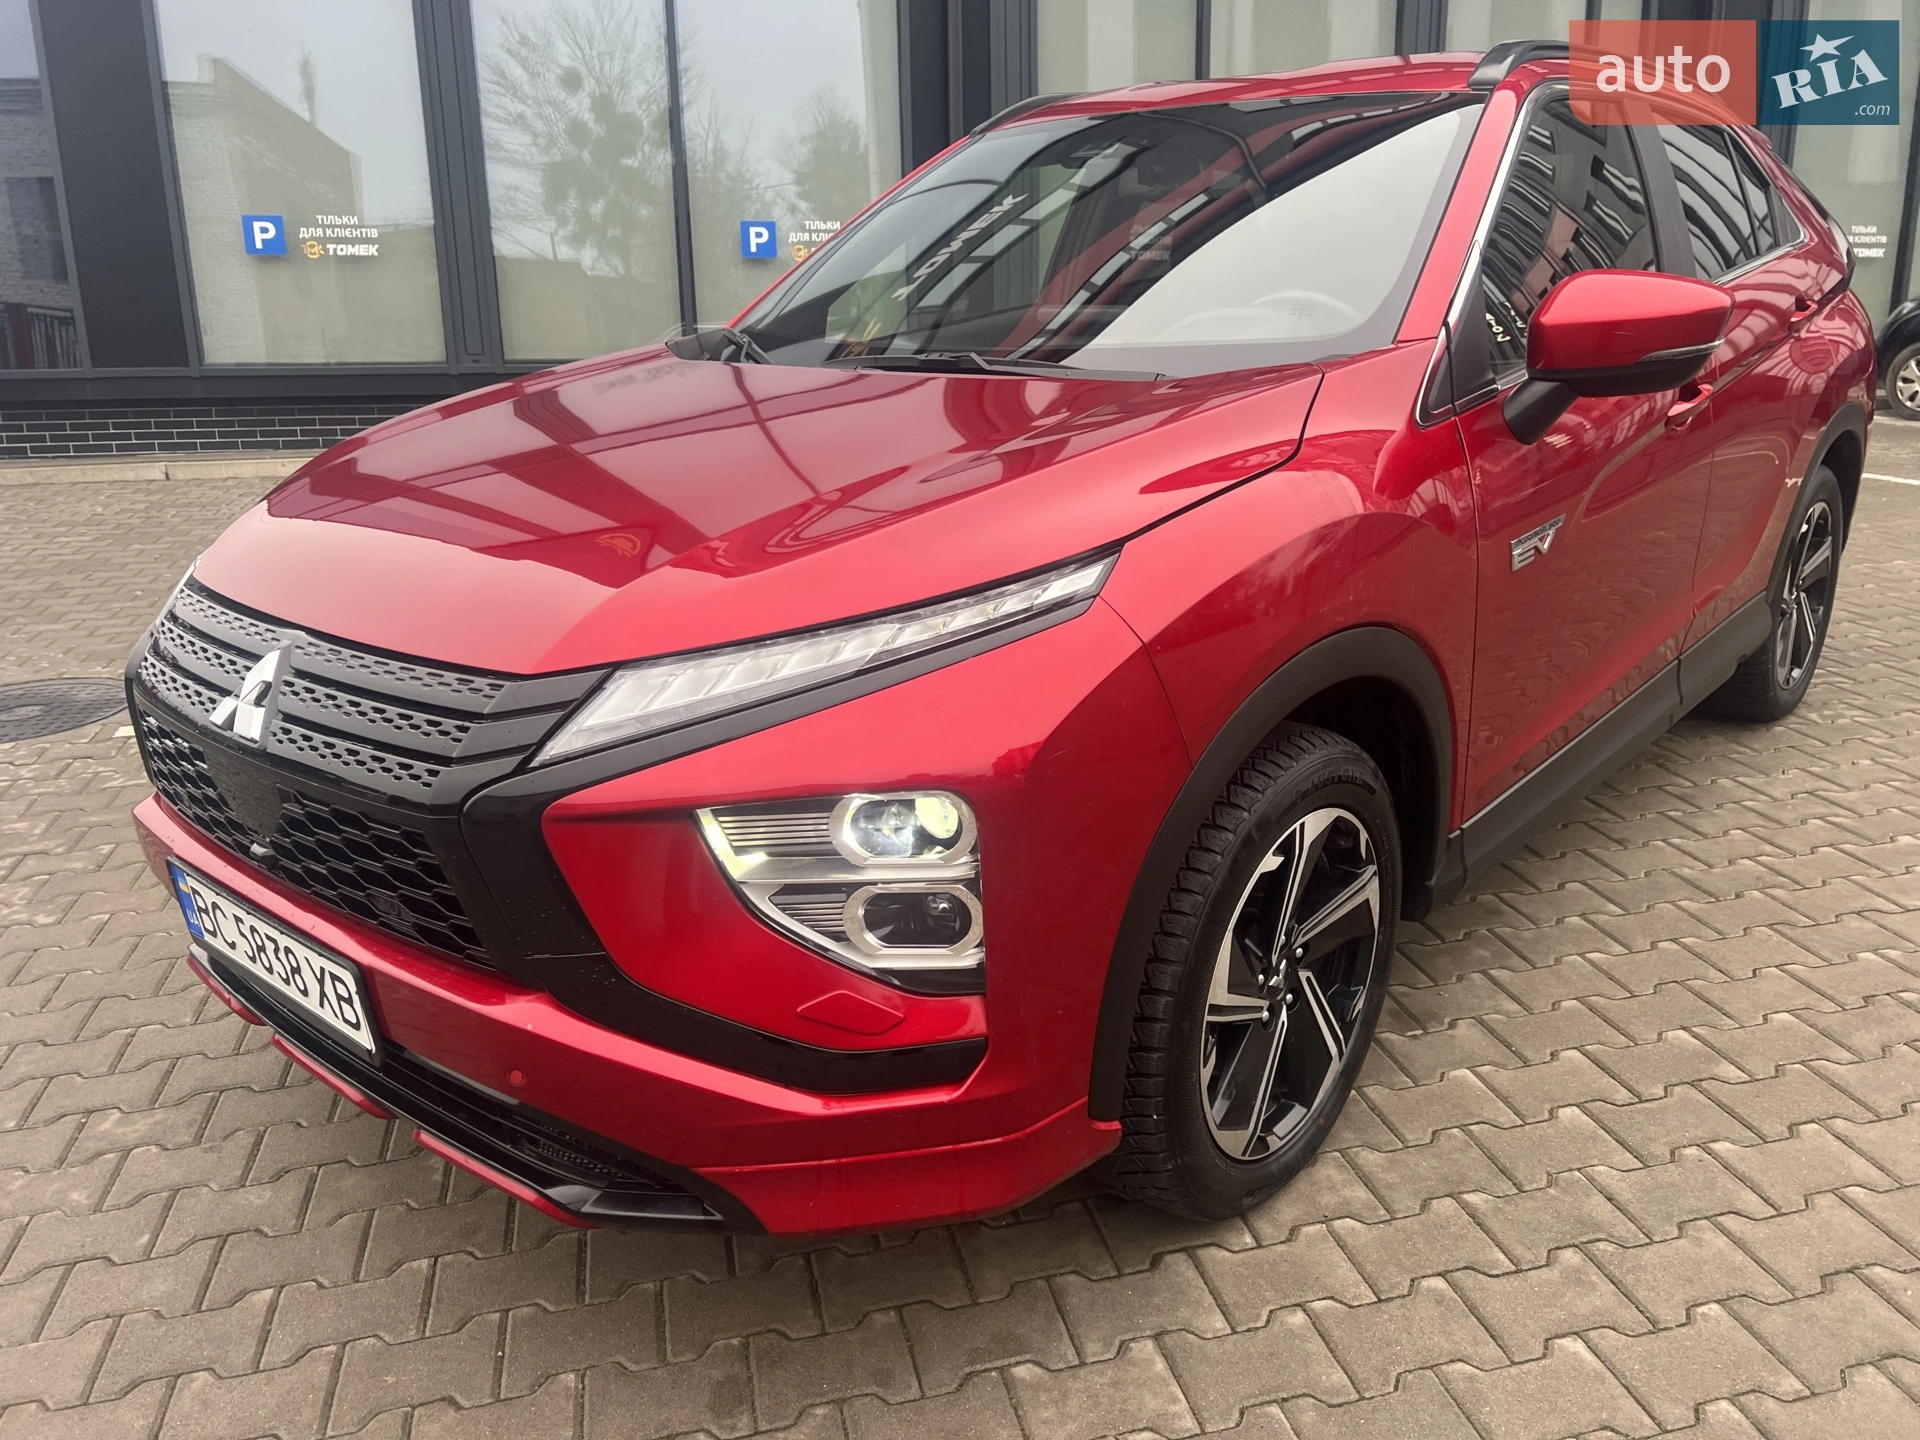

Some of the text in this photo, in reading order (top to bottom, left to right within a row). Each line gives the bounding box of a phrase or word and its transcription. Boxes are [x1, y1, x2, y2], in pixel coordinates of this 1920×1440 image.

[316, 215, 359, 225] ТІЛЬКИ
[804, 221, 841, 230] ТІЛЬКИ
[252, 221, 277, 249] P
[299, 228, 379, 239] ДЛЯ КЛІЄНТІВ
[749, 226, 770, 253] P
[788, 232, 810, 243] ДЛЯ
[1511, 528, 1556, 572] EV
[186, 908, 199, 927] UA
[189, 885, 361, 1032] BC 5838 XB
